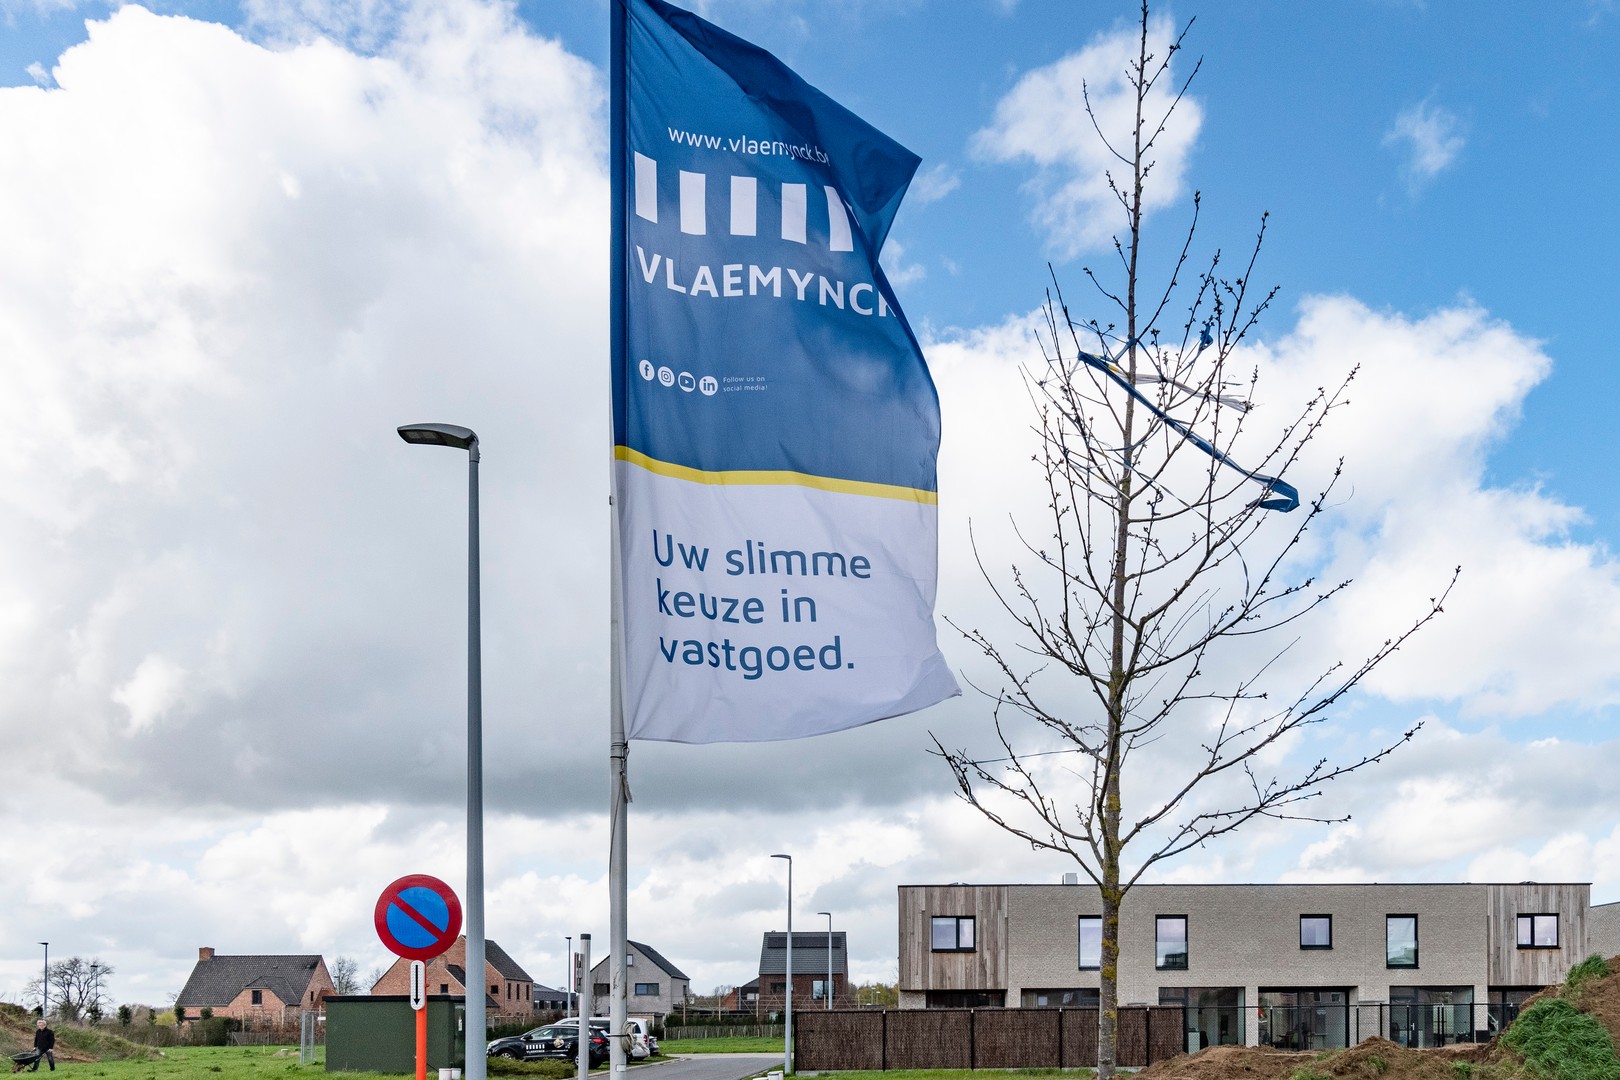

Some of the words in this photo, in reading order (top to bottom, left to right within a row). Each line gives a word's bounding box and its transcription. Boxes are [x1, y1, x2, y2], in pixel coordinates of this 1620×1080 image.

[652, 528, 710, 573] Uw
[725, 539, 872, 579] slimme
[656, 577, 765, 624] keuze
[781, 588, 817, 623] in
[659, 635, 855, 680] vastgoed.
